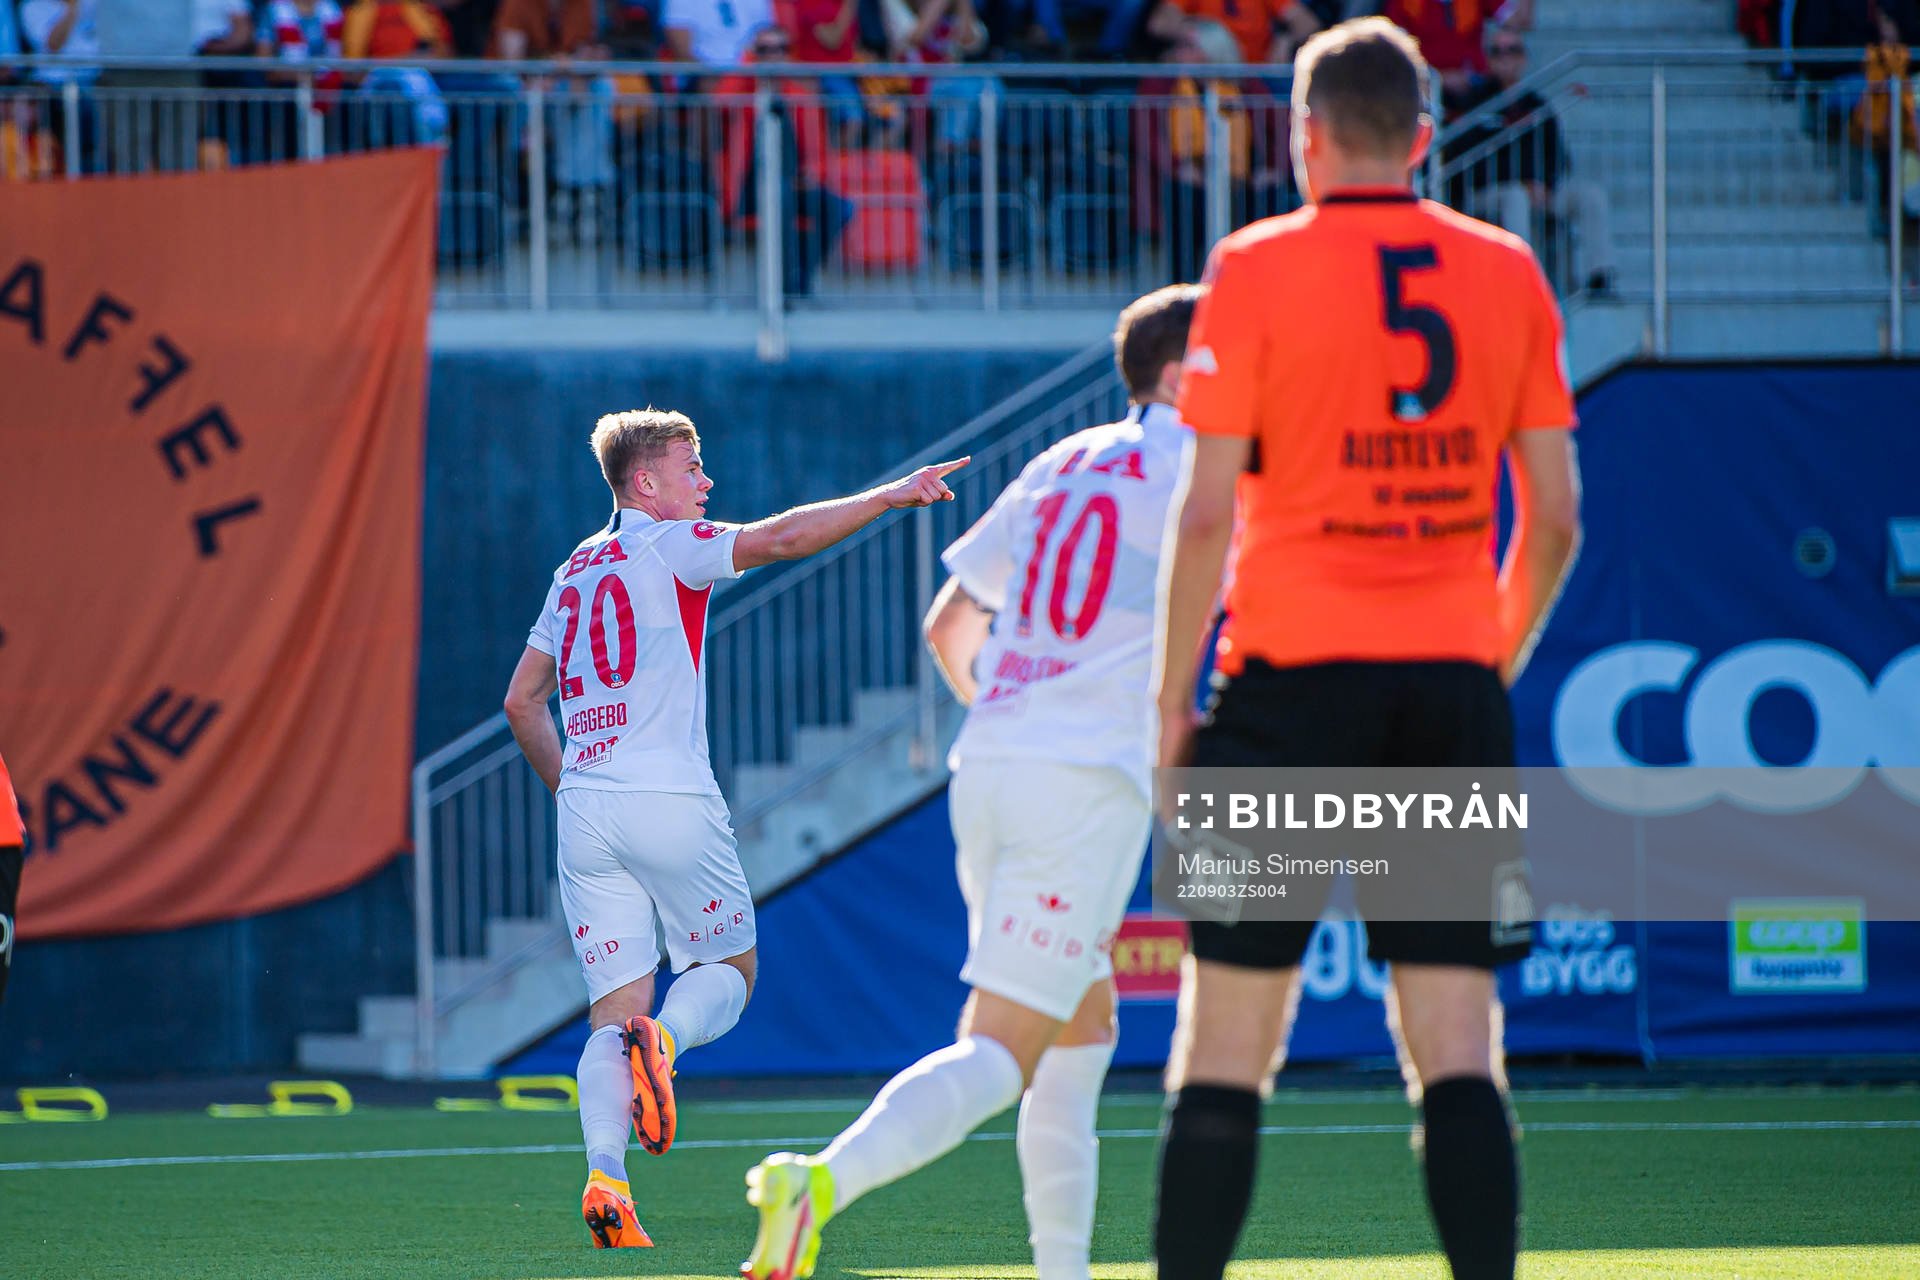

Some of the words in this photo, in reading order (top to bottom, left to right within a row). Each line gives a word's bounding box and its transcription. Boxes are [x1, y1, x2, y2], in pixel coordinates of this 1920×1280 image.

[1378, 243, 1458, 421] 5
[1016, 490, 1120, 641] 10
[556, 574, 637, 701] 20
[566, 702, 628, 737] HEGGEBØ
